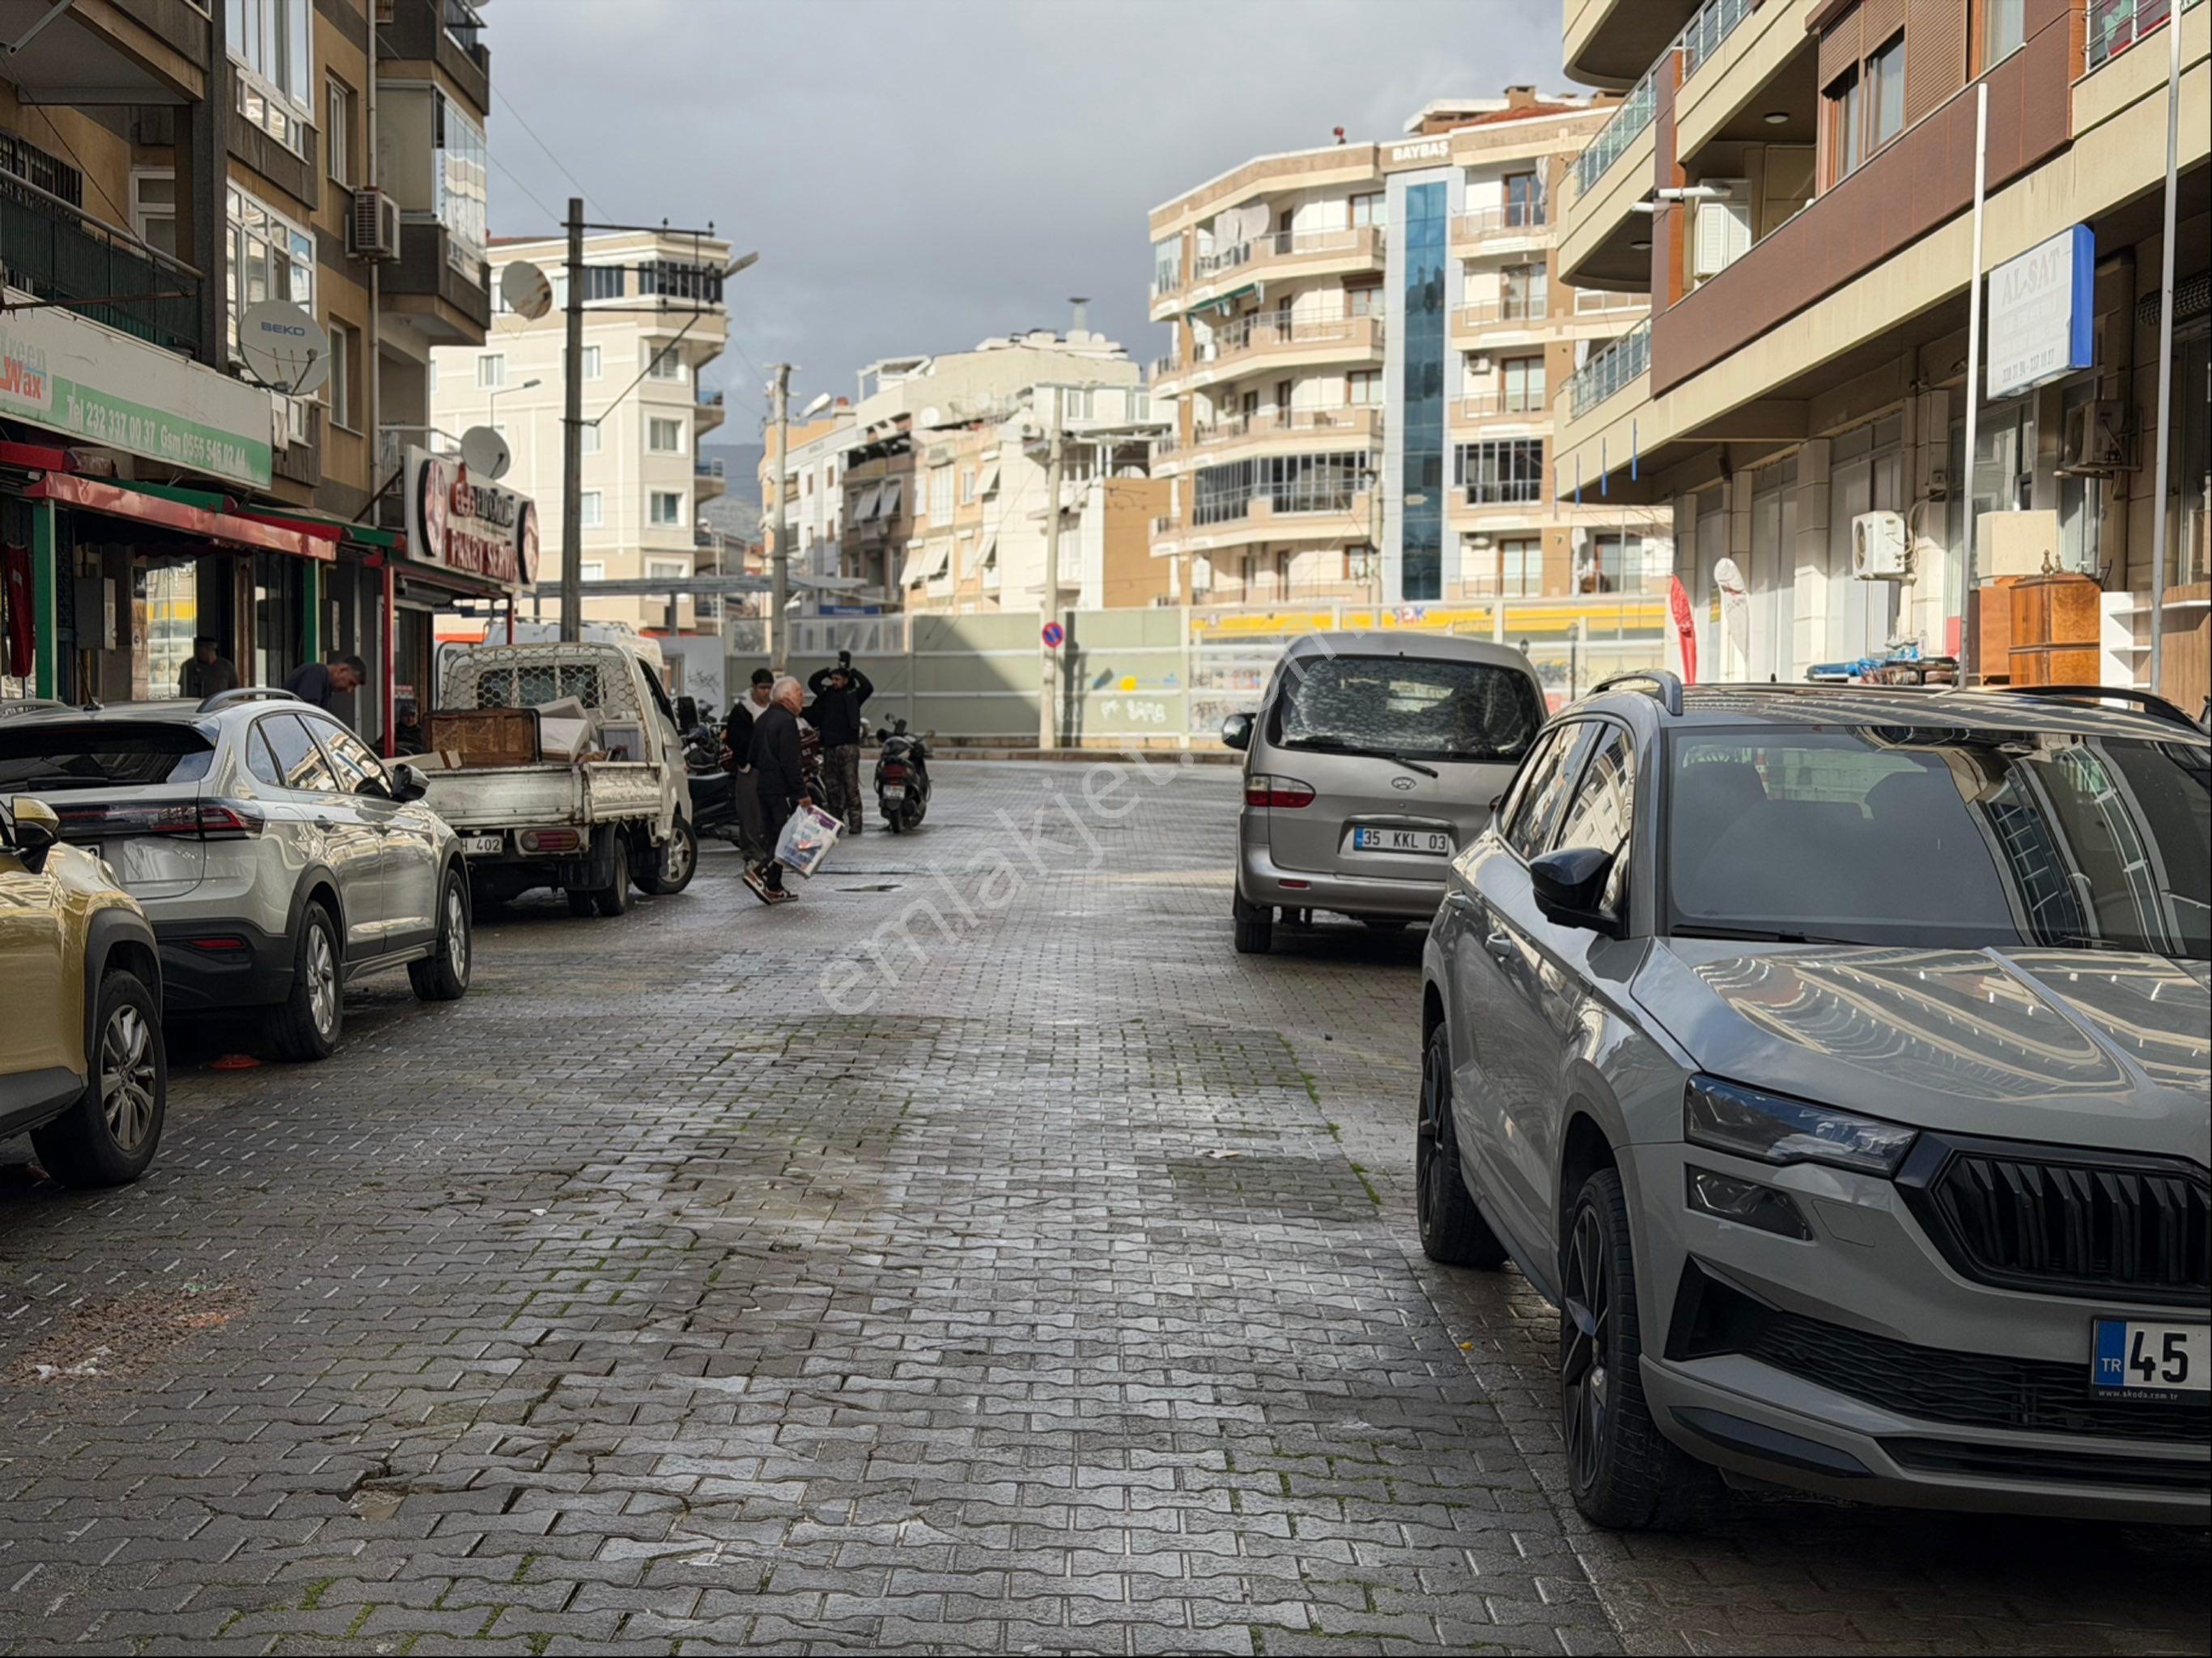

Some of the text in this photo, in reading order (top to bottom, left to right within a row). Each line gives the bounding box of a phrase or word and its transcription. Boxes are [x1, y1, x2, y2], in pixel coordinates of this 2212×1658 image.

[1393, 141, 1449, 162] BAYBAŞ
[2001, 246, 2060, 307] AL-SAT
[261, 321, 305, 337] BEKO
[67, 395, 84, 429] Tel
[87, 401, 106, 431] 232
[108, 409, 127, 439] 337
[129, 416, 142, 443] 00
[143, 421, 156, 447] 37
[160, 425, 181, 453] Gsm
[476, 838, 500, 851] 402
[1364, 830, 1446, 850] 35 KKL 03
[2101, 1330, 2189, 1384] TR 45
